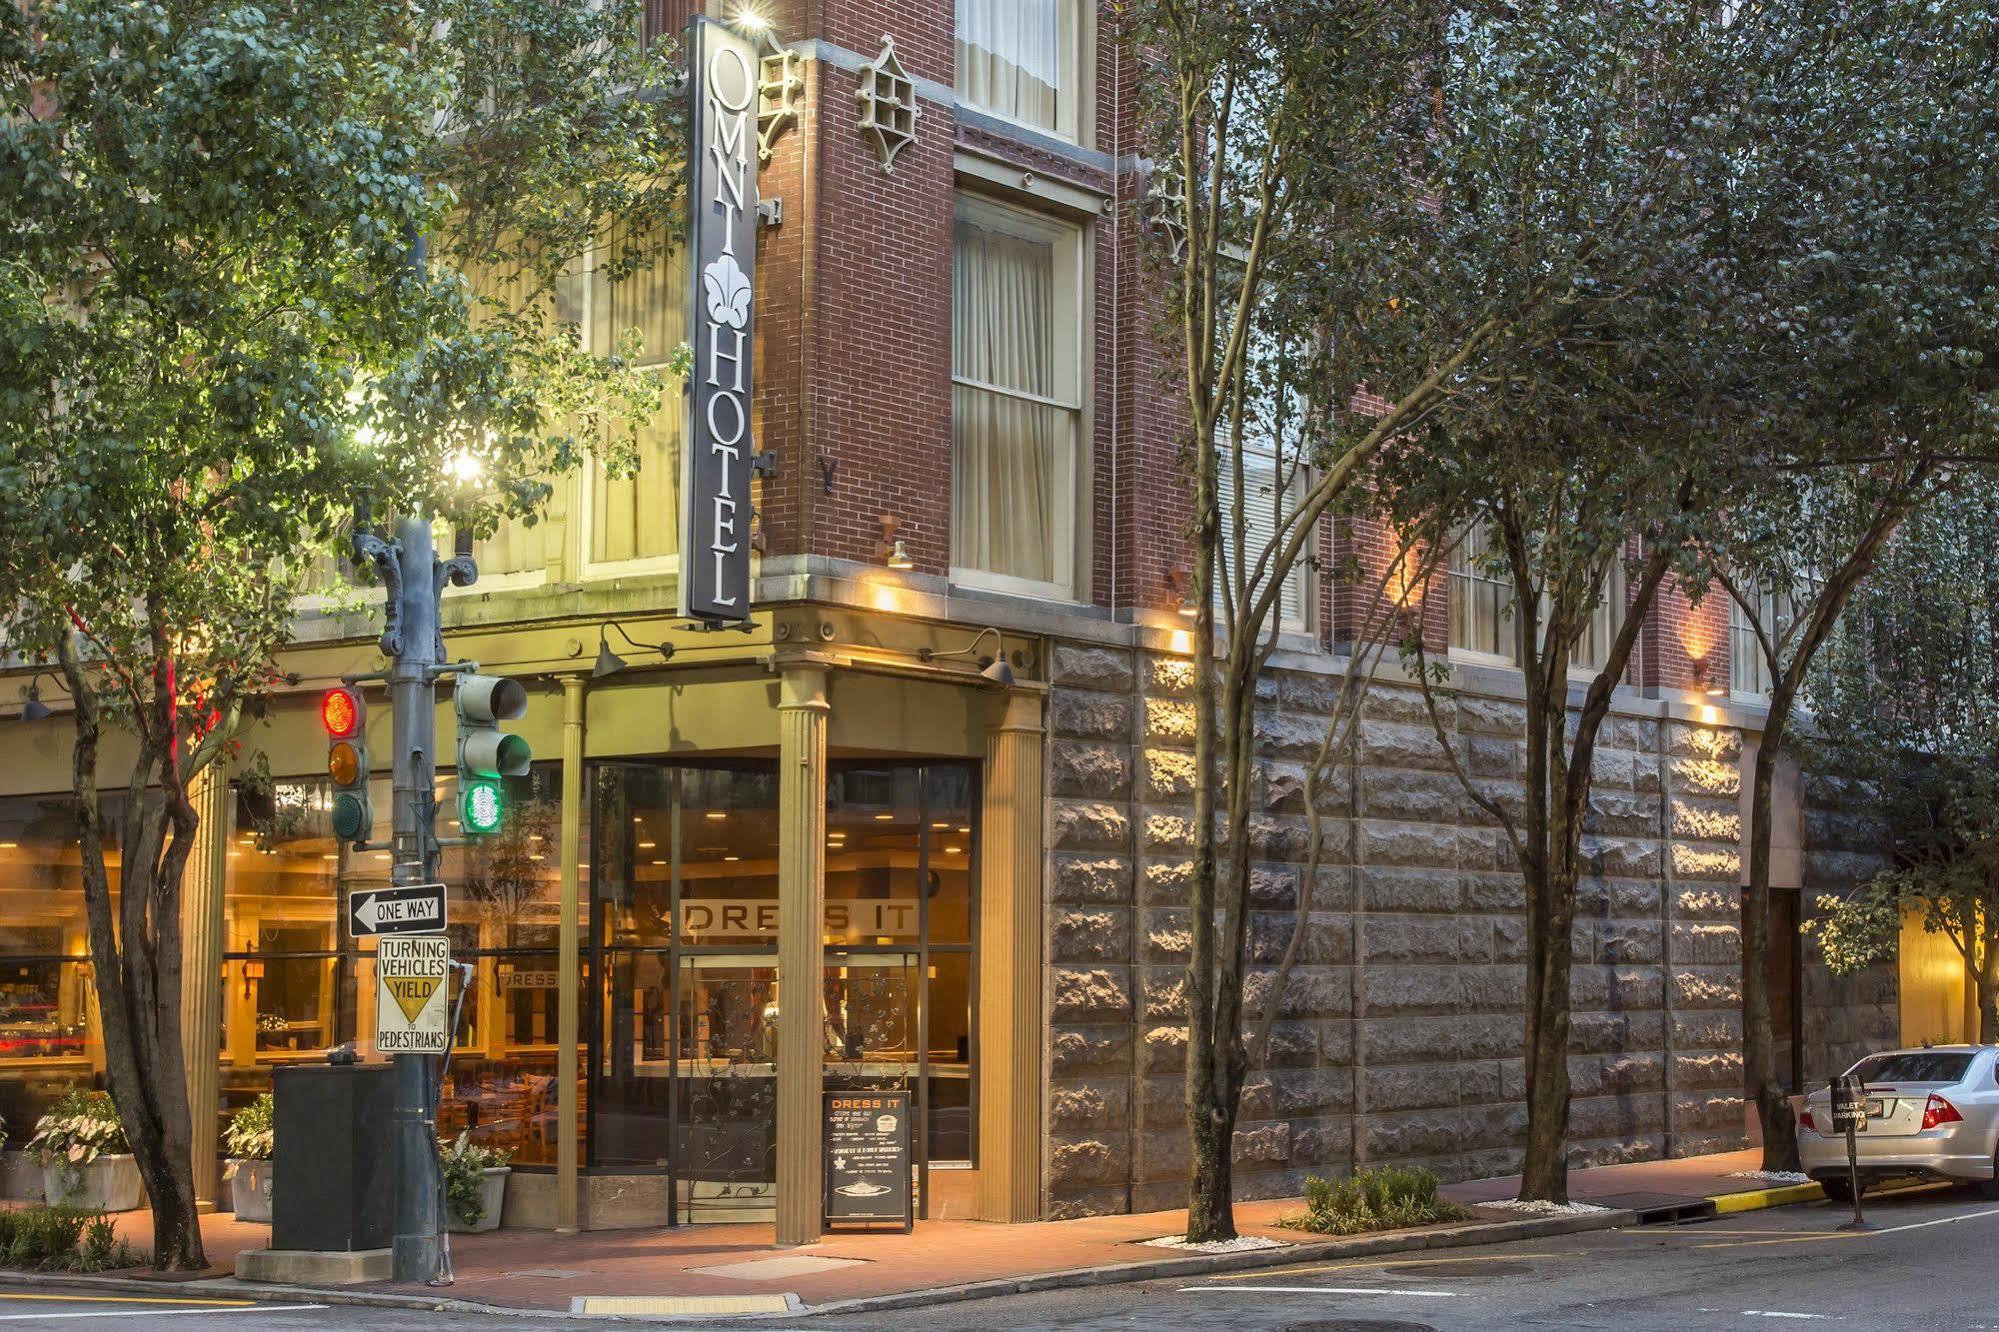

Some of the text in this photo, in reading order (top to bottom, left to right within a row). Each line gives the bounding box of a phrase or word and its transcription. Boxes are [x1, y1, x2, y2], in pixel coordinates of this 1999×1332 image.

[710, 49, 752, 256] OMNI
[706, 321, 748, 606] HOTEL
[377, 900, 434, 920] ONE WAY
[685, 905, 914, 930] DRES IT
[383, 941, 446, 958] TURNING
[382, 959, 445, 976] VEHICLES
[393, 980, 431, 998] YIELD
[379, 1031, 444, 1048] PEDESTRIANS
[831, 1099, 900, 1109] DRESS IT
[1836, 1101, 1859, 1110] VALET
[1834, 1110, 1865, 1118] PARKING
